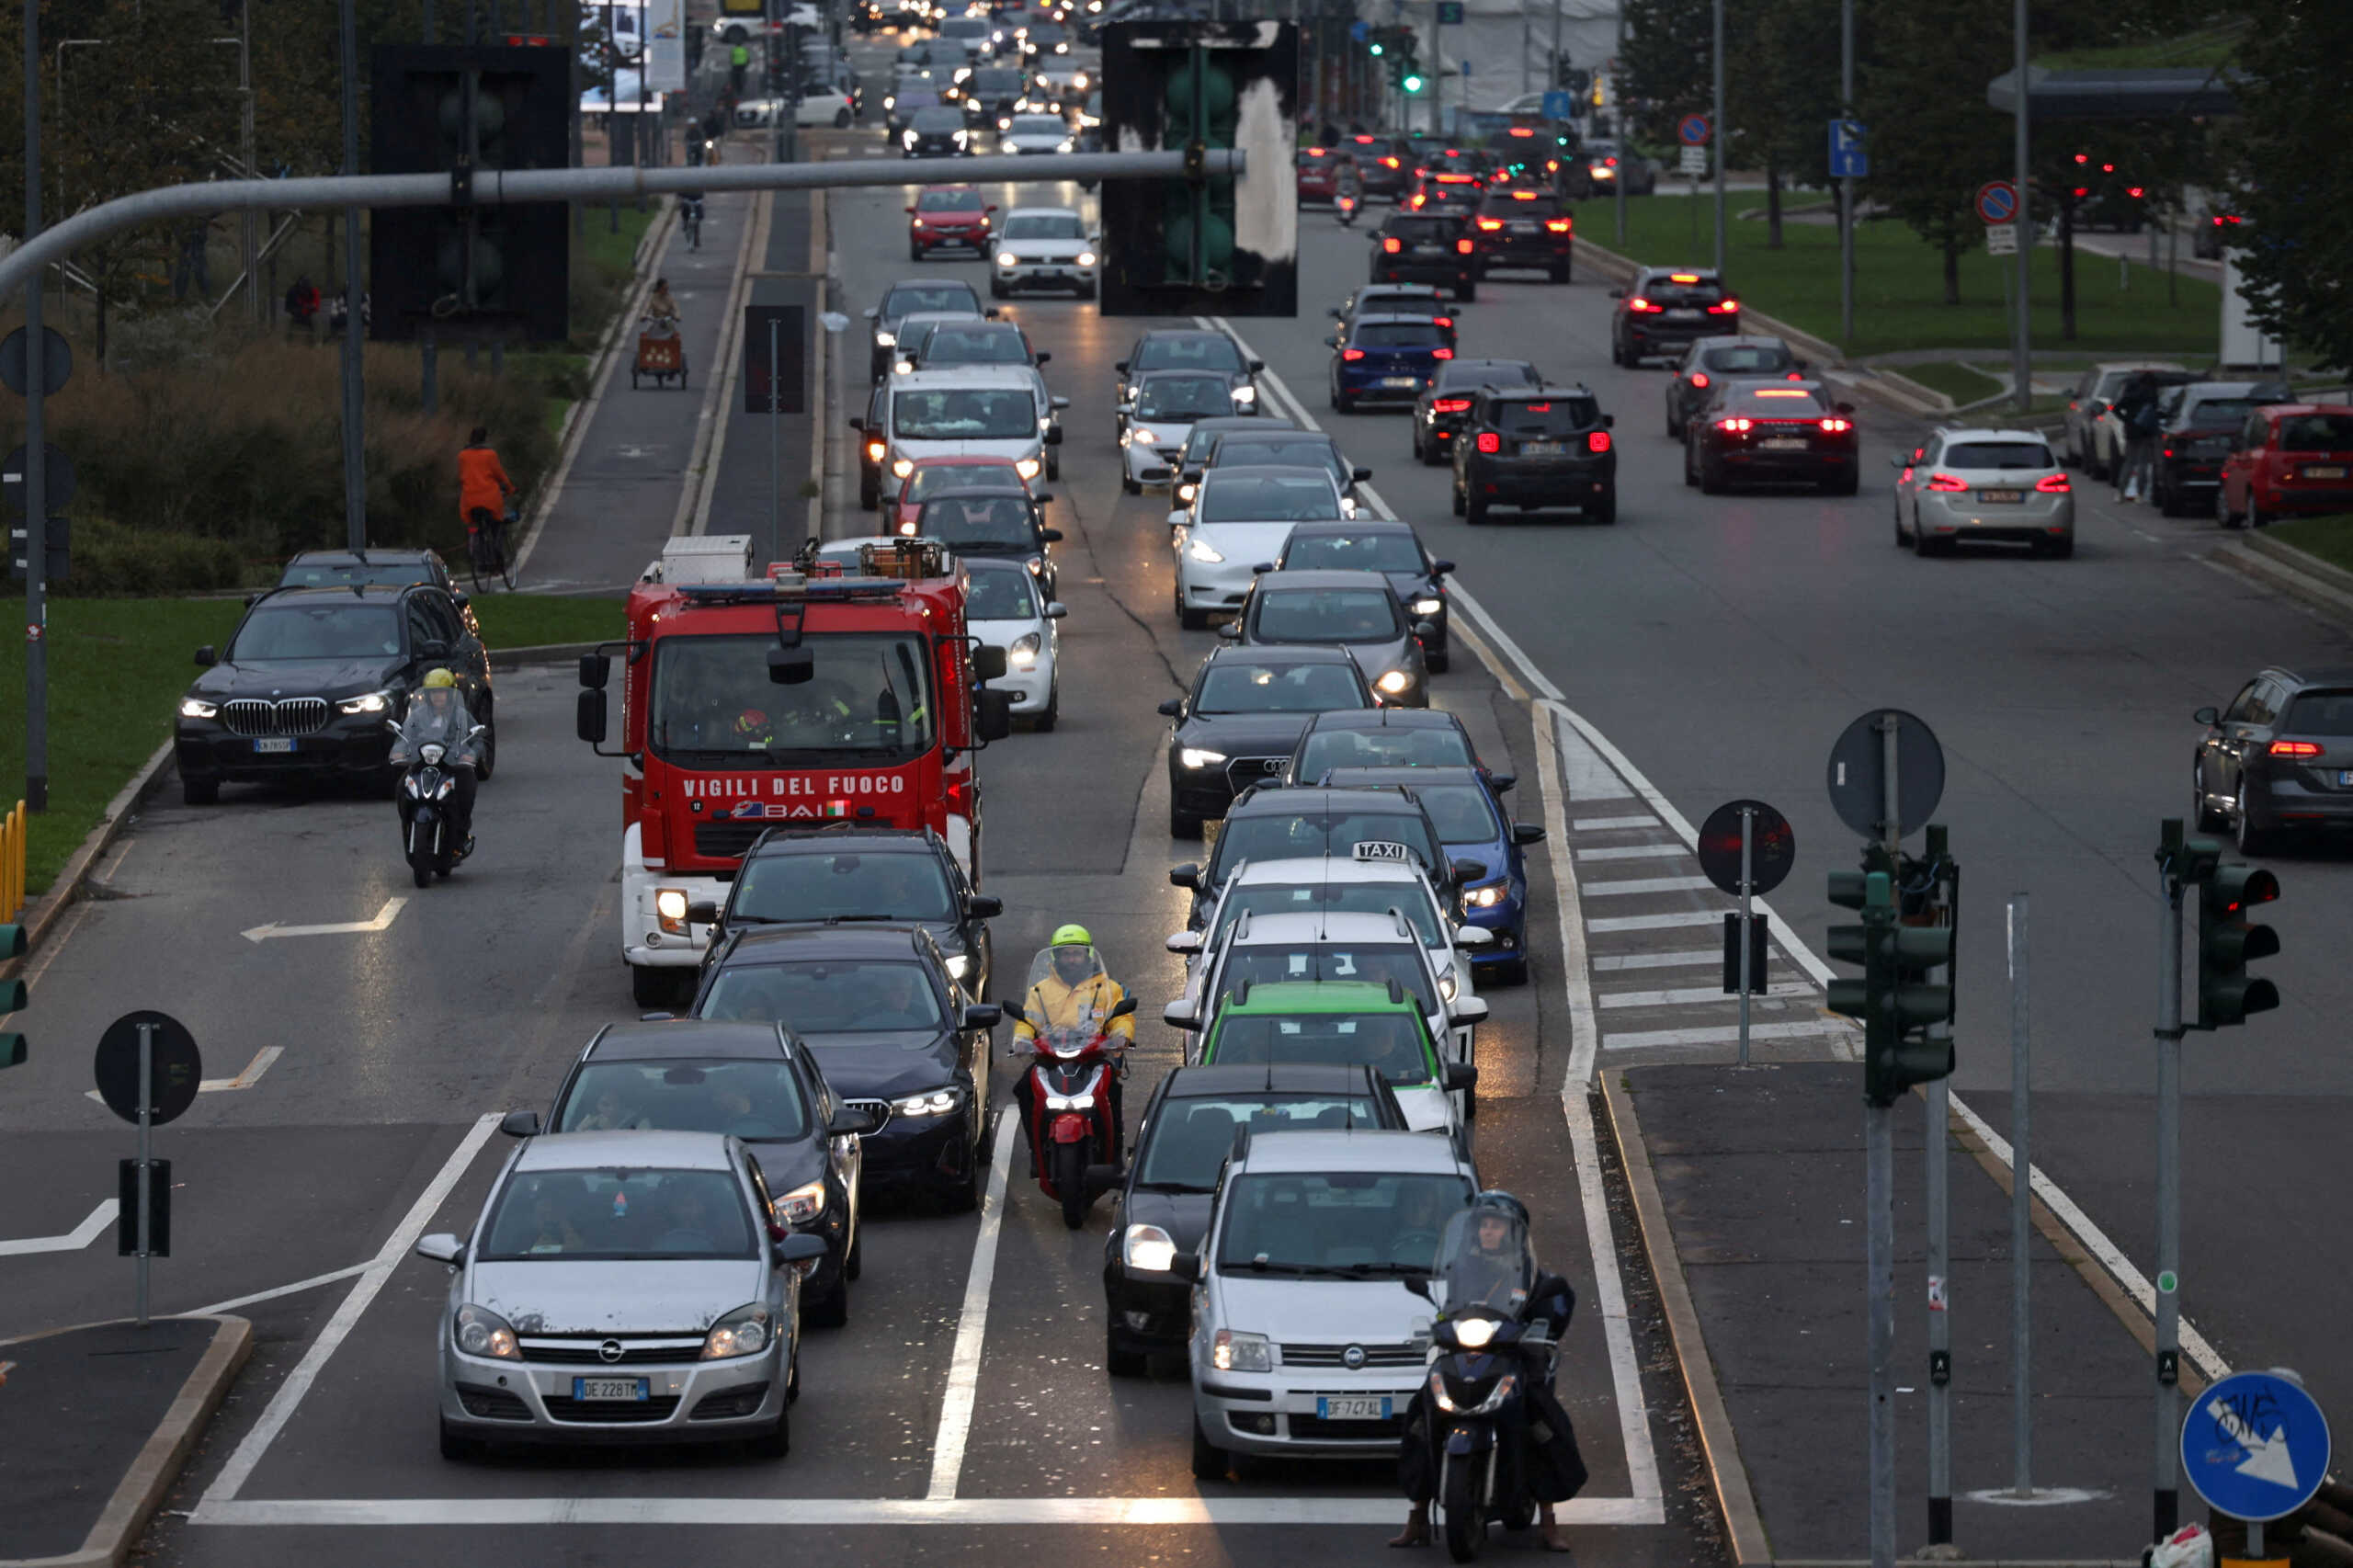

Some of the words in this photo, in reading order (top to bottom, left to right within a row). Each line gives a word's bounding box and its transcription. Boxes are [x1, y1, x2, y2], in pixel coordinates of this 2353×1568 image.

[683, 778, 758, 797] VIGILI
[772, 777, 815, 796] DEL
[828, 775, 904, 795] FUOCO
[764, 803, 823, 817] BAI
[1360, 843, 1400, 858] TAXI
